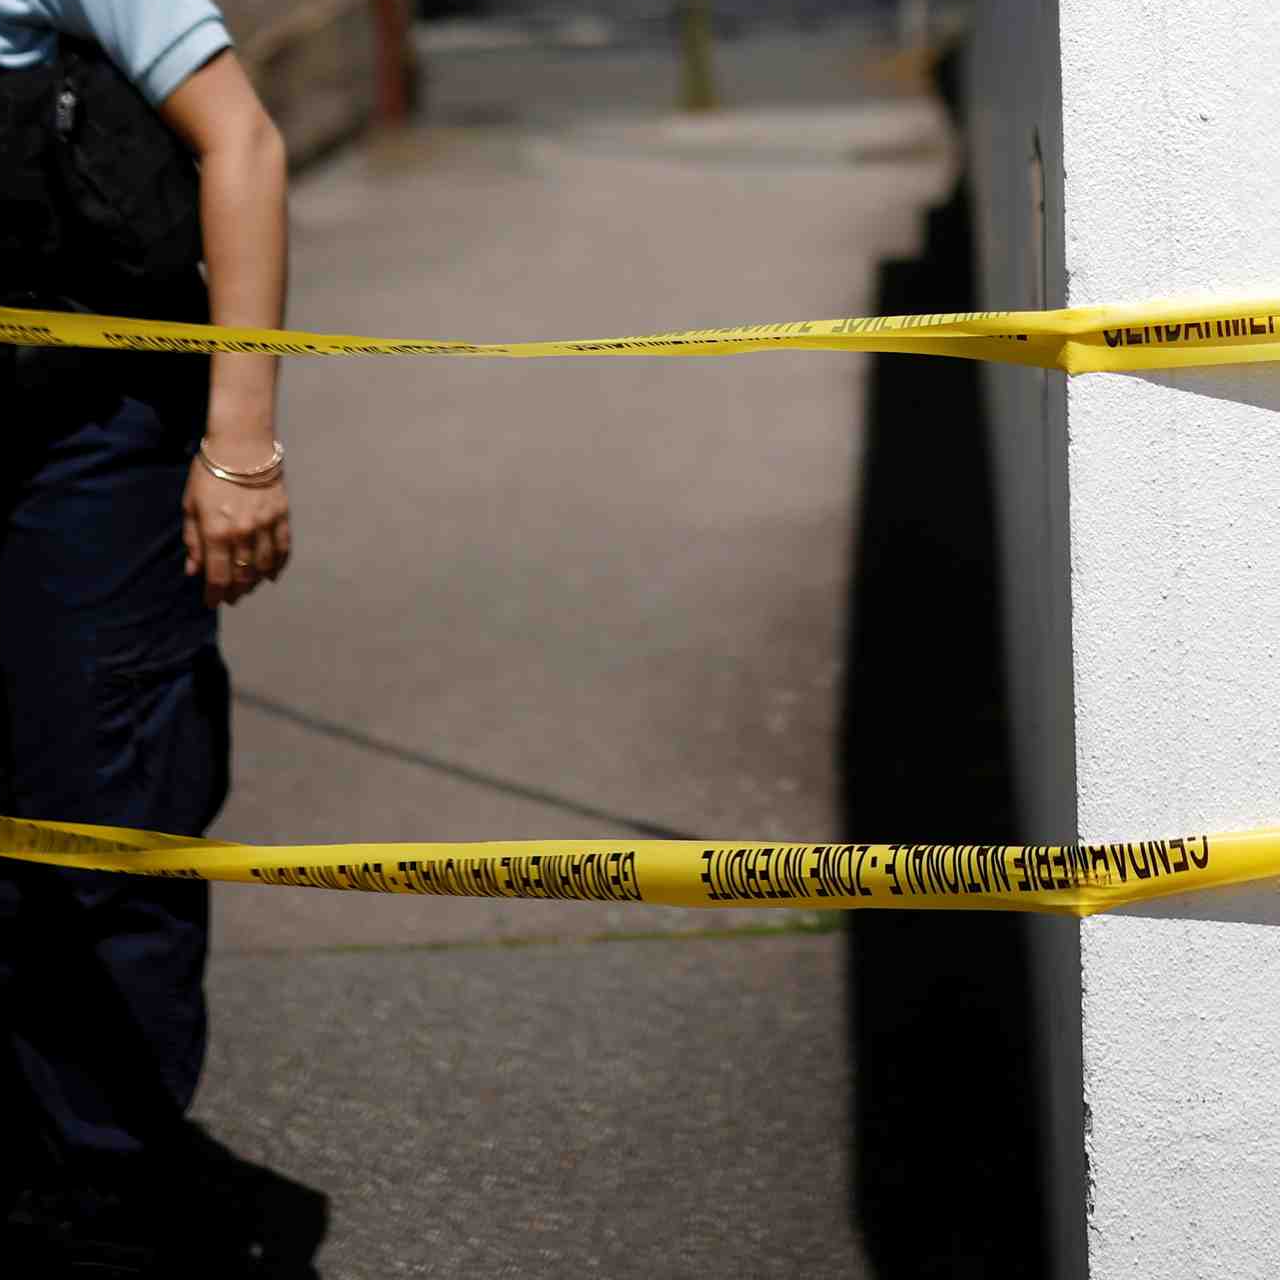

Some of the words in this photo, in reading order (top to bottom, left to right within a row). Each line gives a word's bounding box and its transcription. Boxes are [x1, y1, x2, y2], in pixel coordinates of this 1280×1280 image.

[700, 847, 811, 901] INTERDITE
[809, 845, 873, 898] ZONE
[884, 844, 1013, 896] NATIONALE
[1013, 835, 1210, 892] GENDARMERIE
